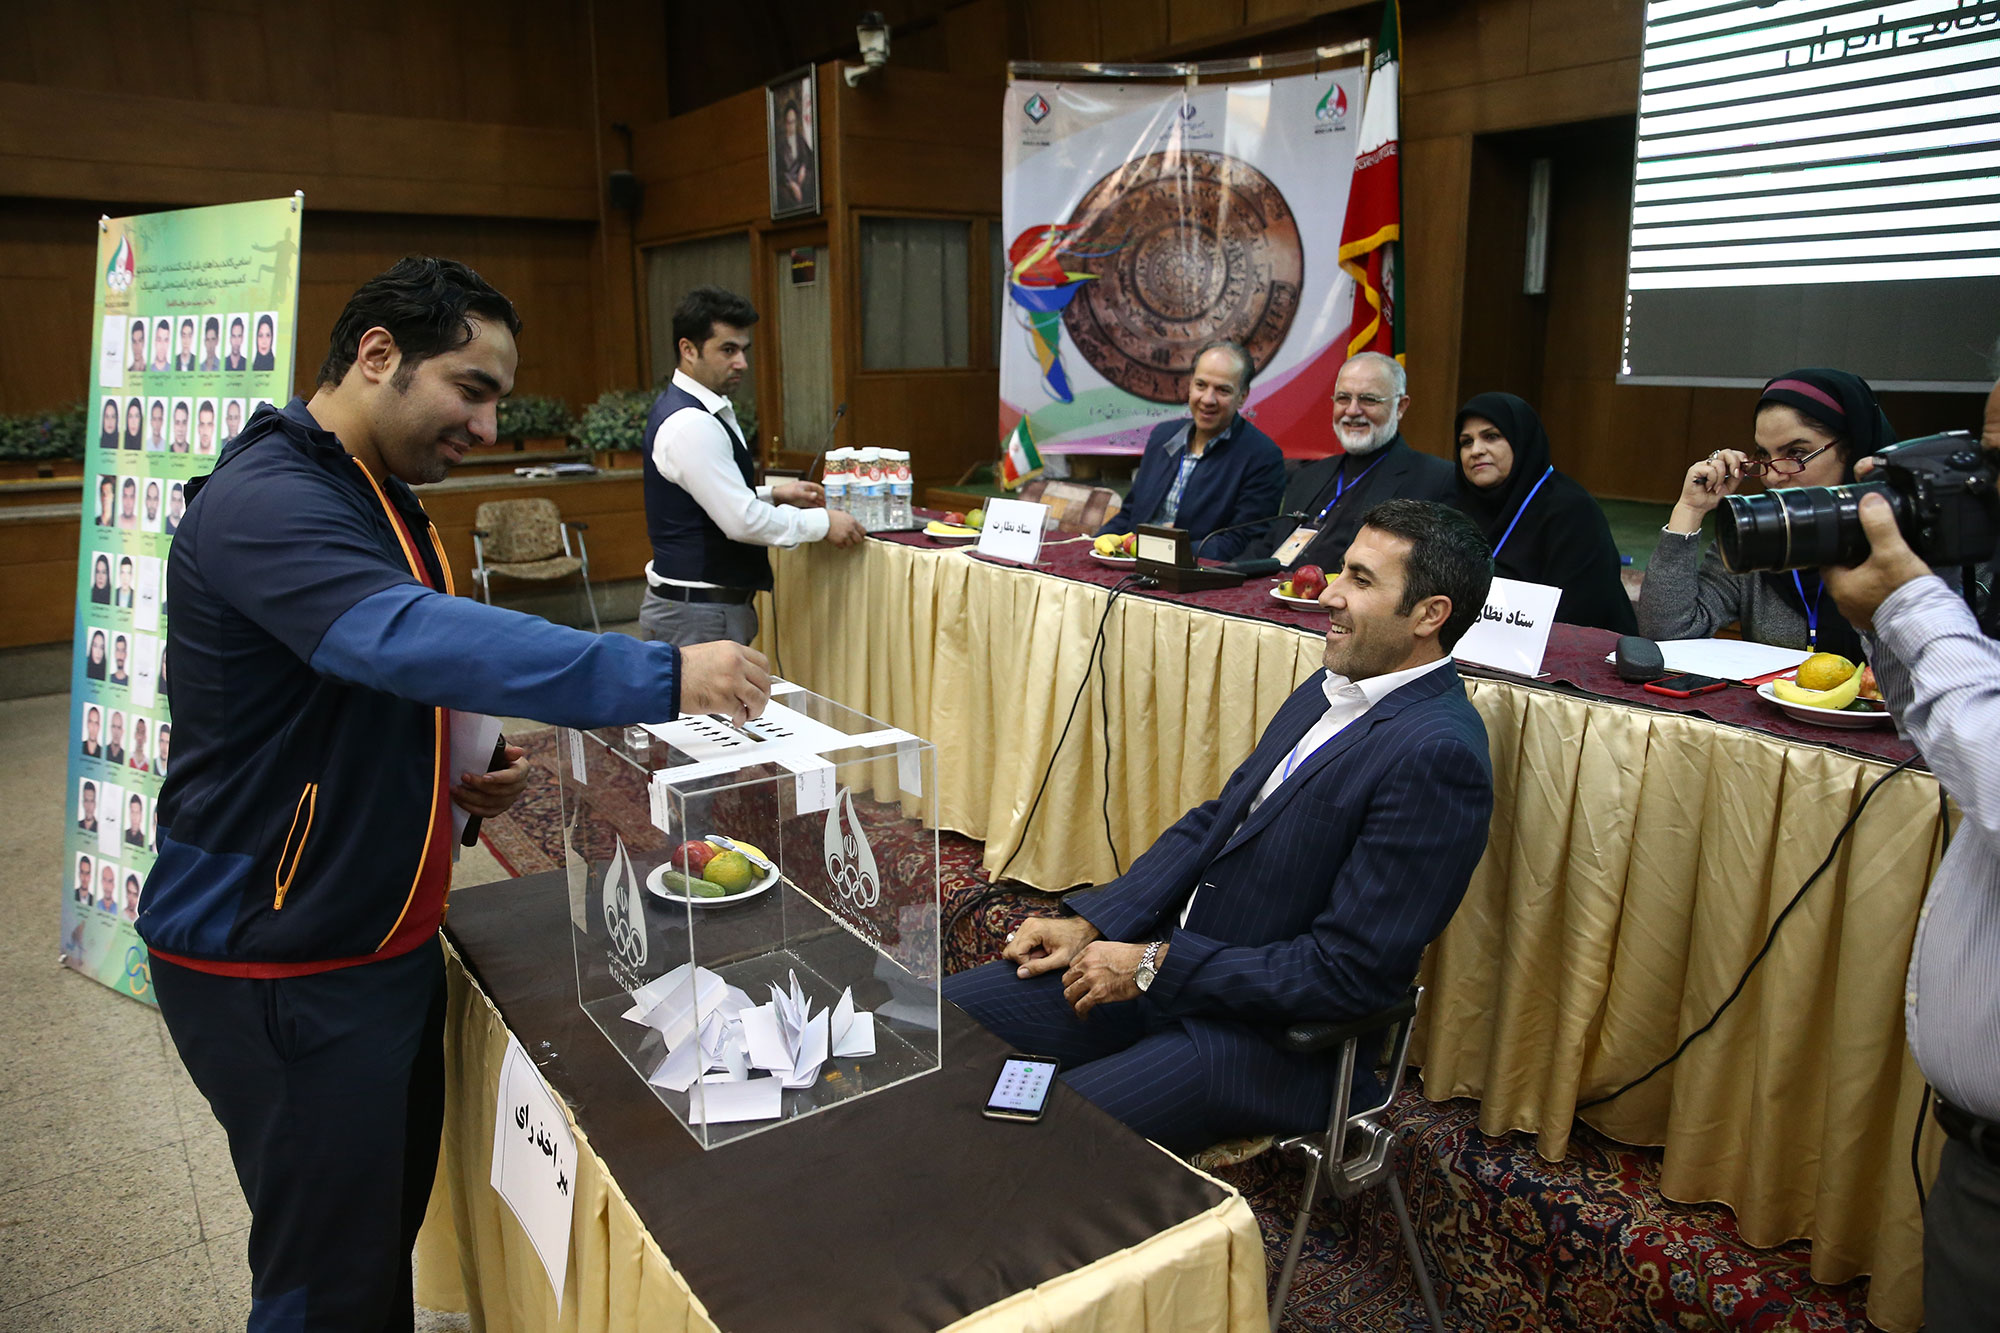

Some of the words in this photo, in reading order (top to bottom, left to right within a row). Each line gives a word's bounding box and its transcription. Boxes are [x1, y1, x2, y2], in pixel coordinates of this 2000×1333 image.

[992, 520, 1015, 534] نظارت
[1016, 523, 1031, 534] ستاد
[1474, 603, 1504, 623] نظار
[1505, 609, 1535, 629] ستاد
[515, 1104, 535, 1145] رای
[537, 1120, 558, 1169] اخذ
